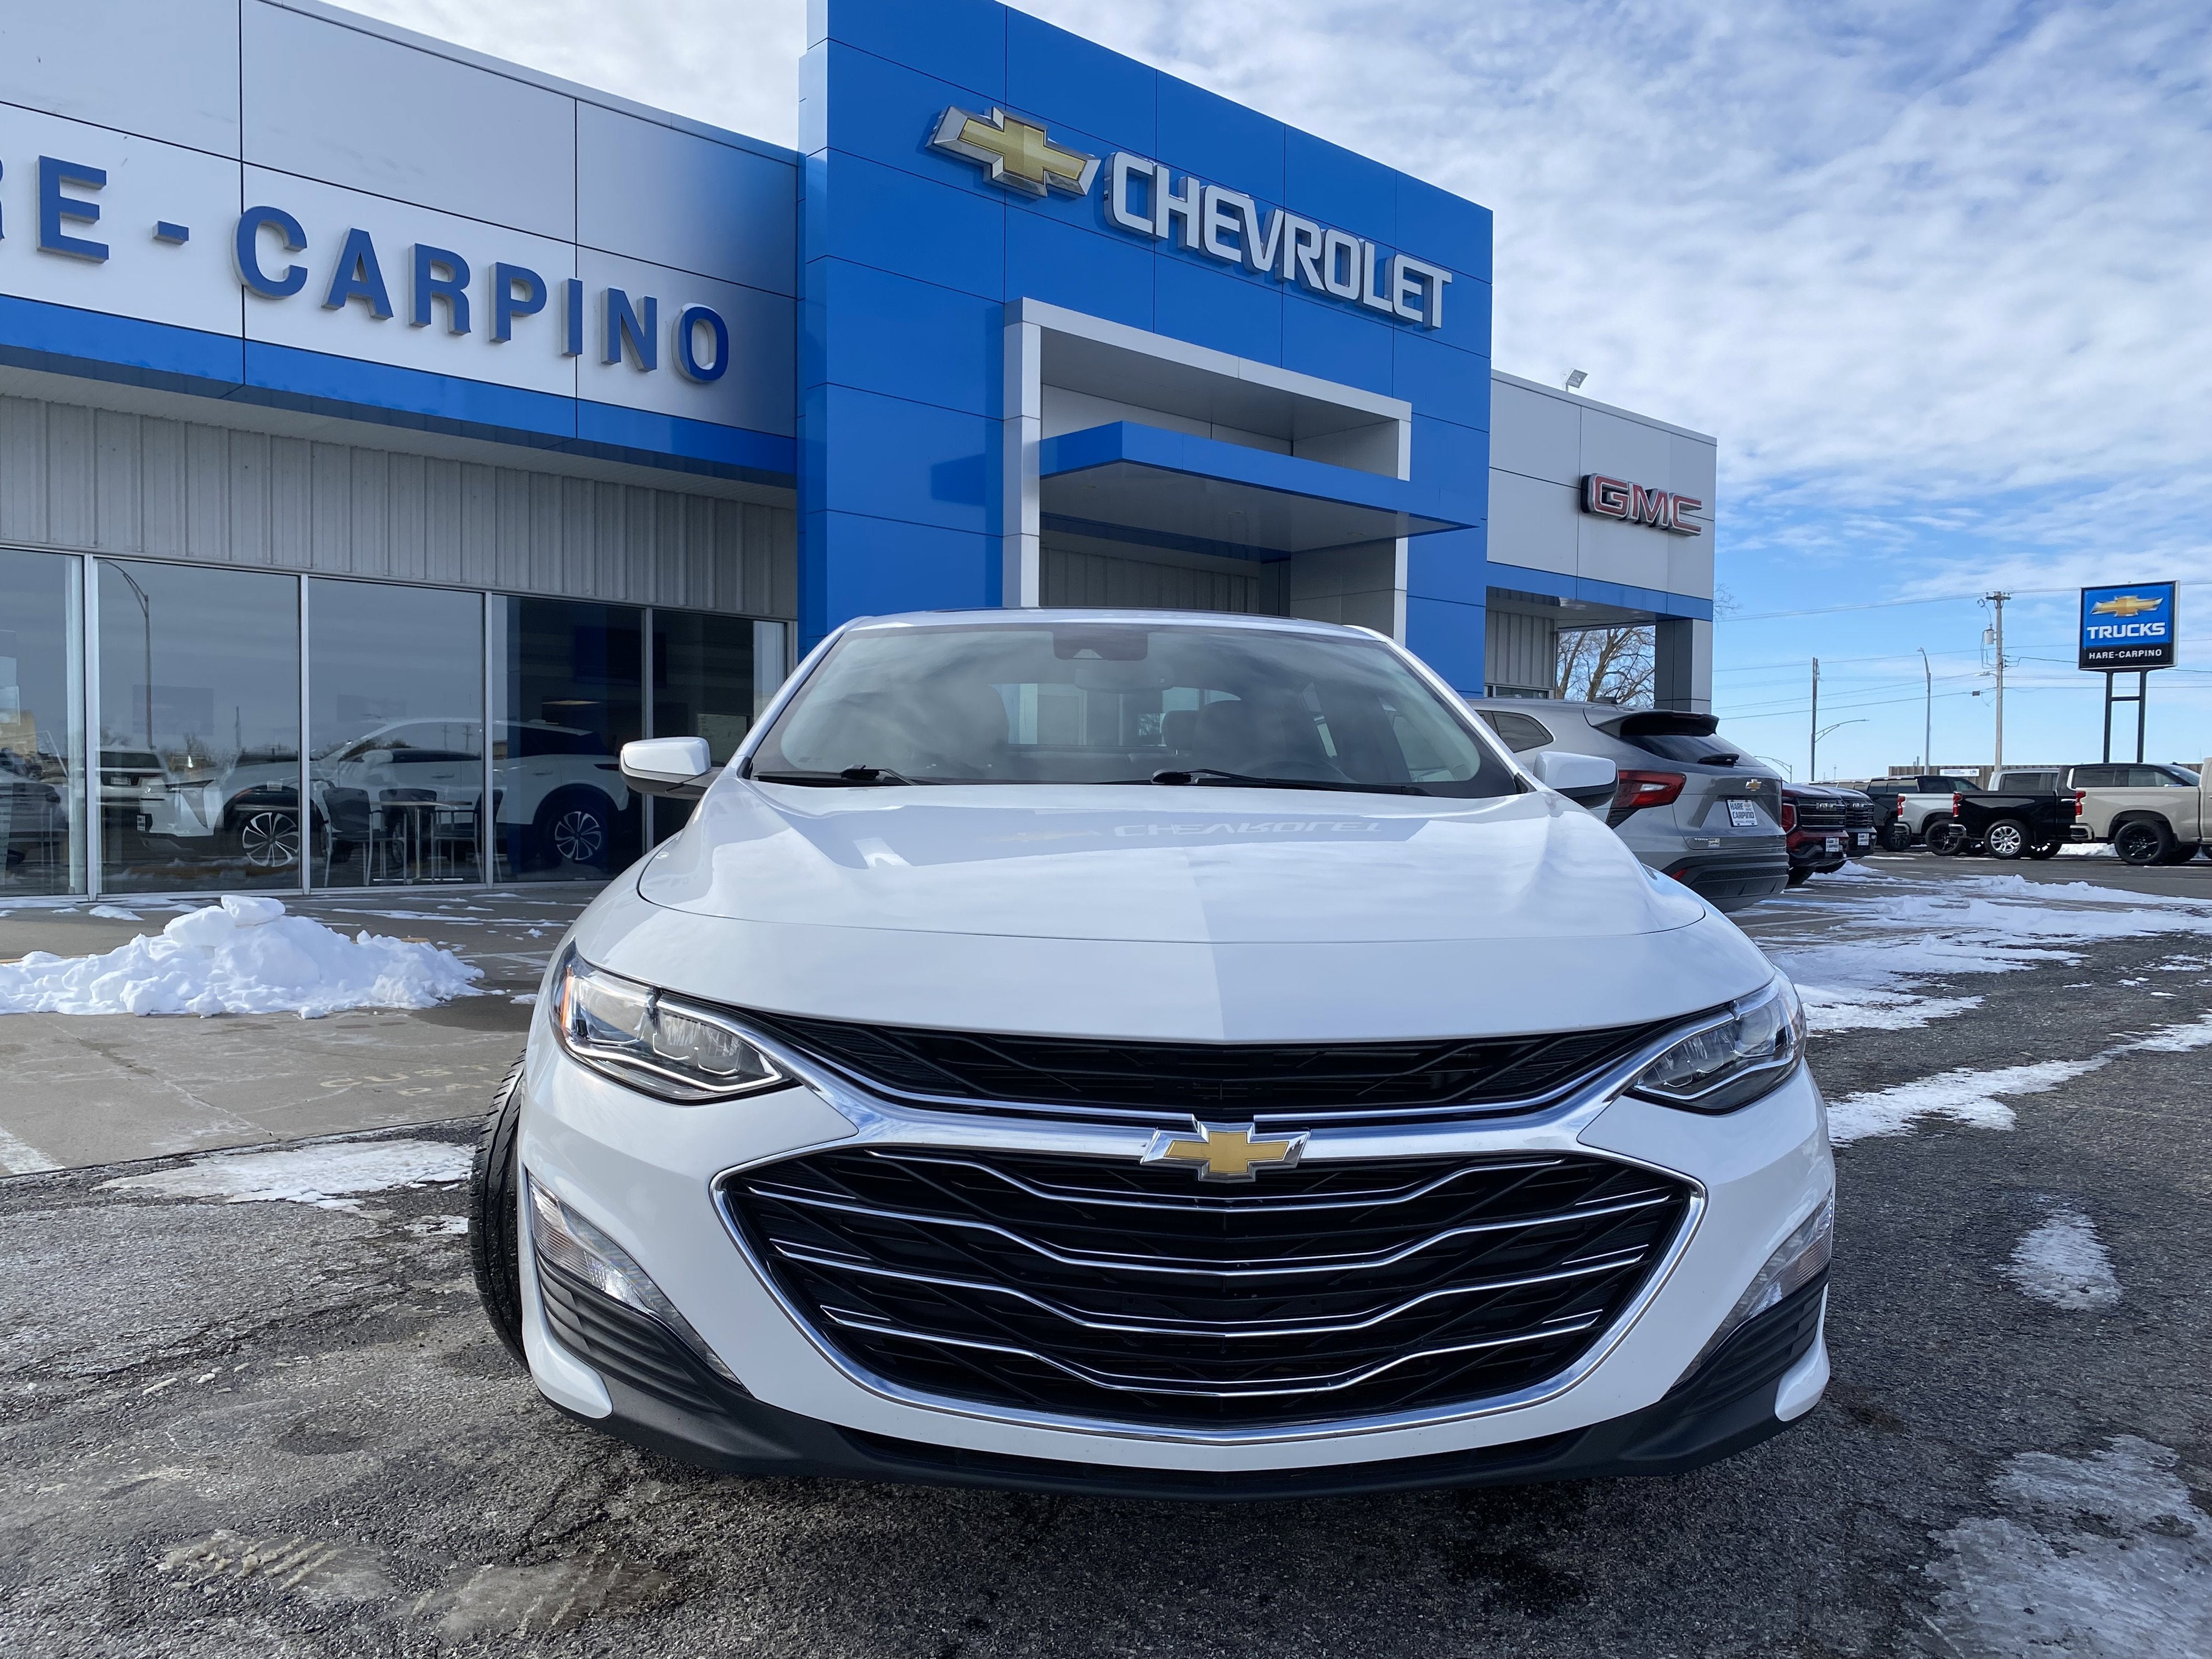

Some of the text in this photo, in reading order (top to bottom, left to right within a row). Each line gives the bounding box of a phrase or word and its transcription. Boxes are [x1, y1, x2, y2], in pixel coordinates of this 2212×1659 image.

[0, 155, 109, 264] E
[232, 205, 729, 383] CARPINO
[1104, 151, 1453, 329] CHEVROLET
[1583, 472, 1702, 537] GMC
[2087, 622, 2166, 639] TRUCKS
[2089, 649, 2162, 659] HARE-CARPINO
